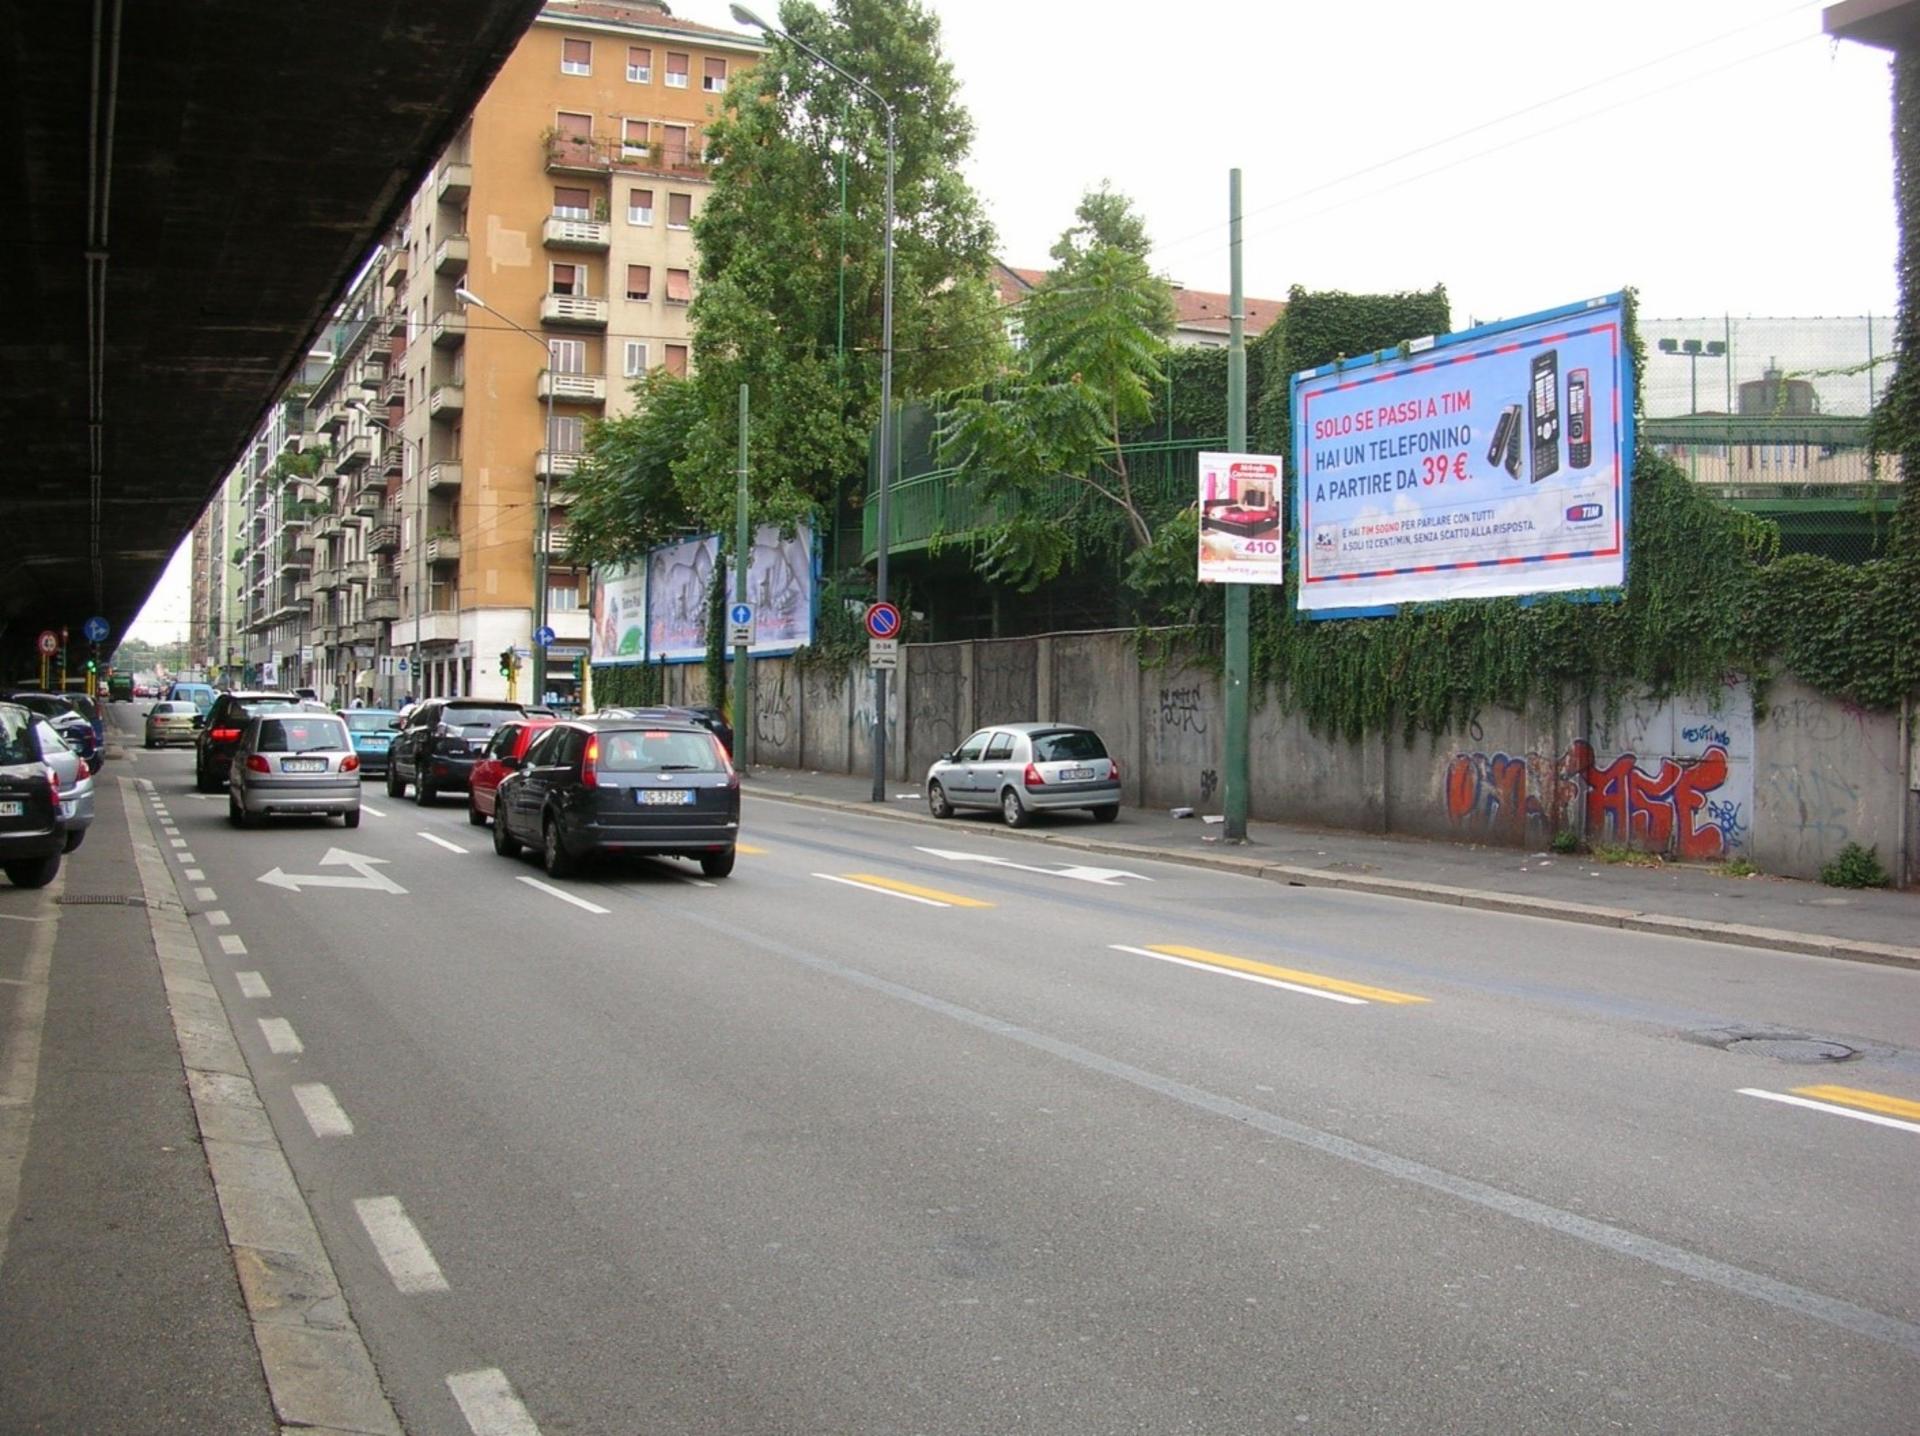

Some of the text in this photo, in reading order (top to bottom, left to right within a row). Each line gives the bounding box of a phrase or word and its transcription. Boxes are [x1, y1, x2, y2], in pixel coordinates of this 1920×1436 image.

[1315, 390, 1471, 440] SOLO SE PASSI A TIM
[1316, 425, 1471, 471] HAI UN TELEFONINO
[1315, 483, 1326, 502] A
[1329, 472, 1392, 500] PARTIRE
[1397, 468, 1418, 490] DA
[1422, 454, 1448, 486] 39
[1361, 525, 1374, 535] TIM
[1375, 522, 1400, 534] SOGNO
[1401, 520, 1416, 531] PER
[1418, 514, 1451, 529] PARLARE
[1453, 512, 1469, 524] CON
[1472, 509, 1495, 521] TUTTI
[1583, 506, 1599, 519] TIM
[1245, 541, 1276, 554] 410
[1347, 540, 1364, 551] SOLI
[1366, 539, 1373, 549] 12
[1414, 531, 1438, 543] SENZA
[1440, 527, 1469, 541] SCATTO
[1470, 525, 1491, 537] ALLA
[1493, 520, 1536, 534] RISPOSTA.
